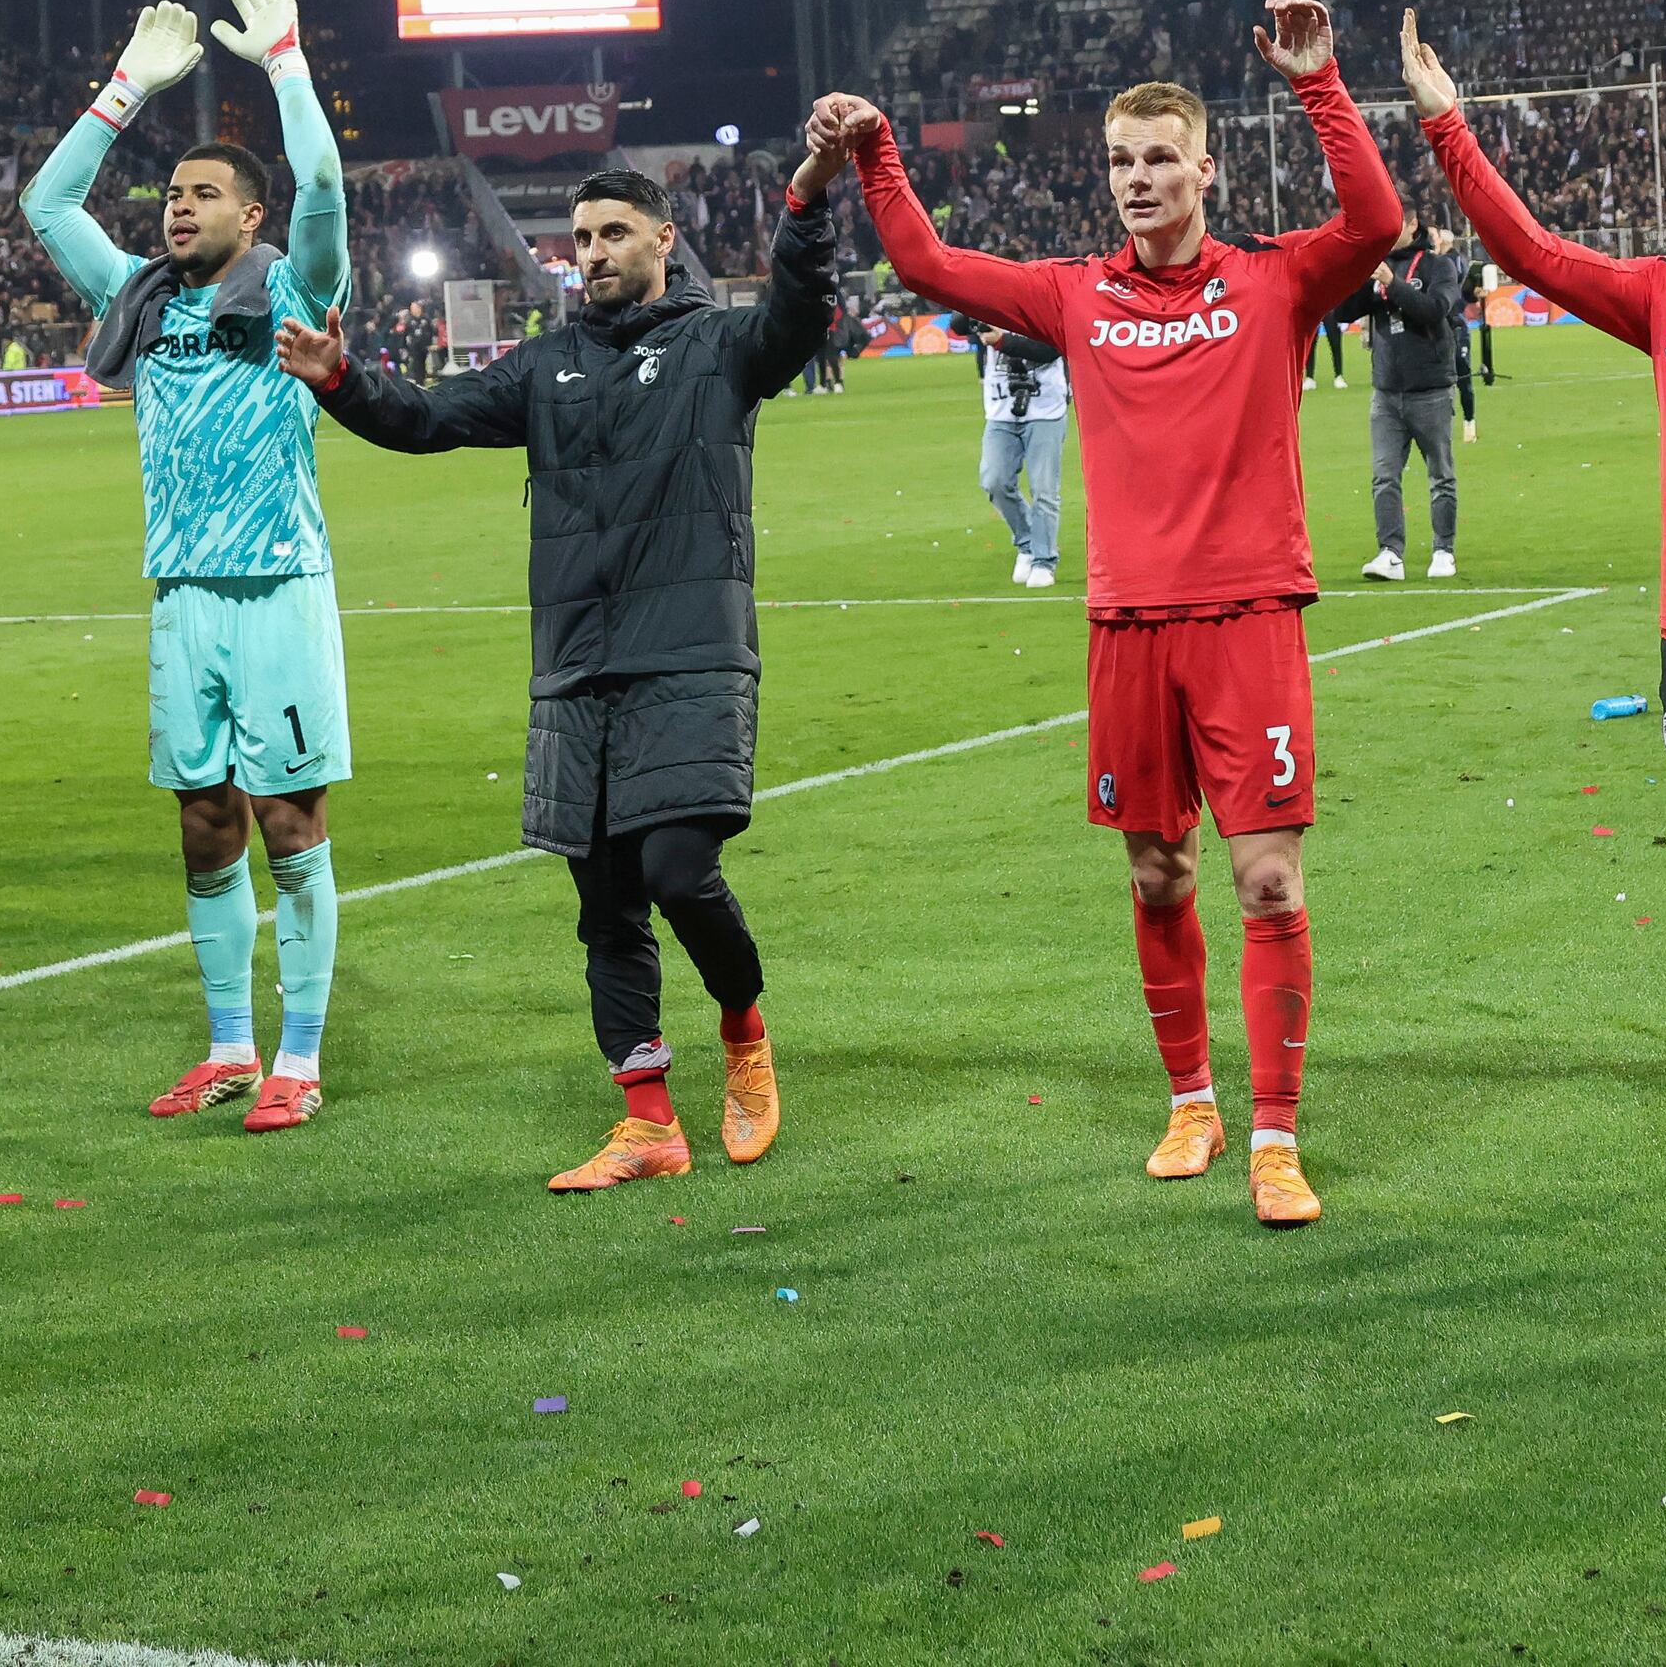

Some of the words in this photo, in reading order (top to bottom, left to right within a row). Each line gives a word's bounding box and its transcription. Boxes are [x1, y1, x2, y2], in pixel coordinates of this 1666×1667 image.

[144, 326, 249, 359] OBRAD
[1089, 309, 1238, 347] JOBRAD
[282, 704, 308, 756] 1
[1266, 724, 1296, 787] 3
